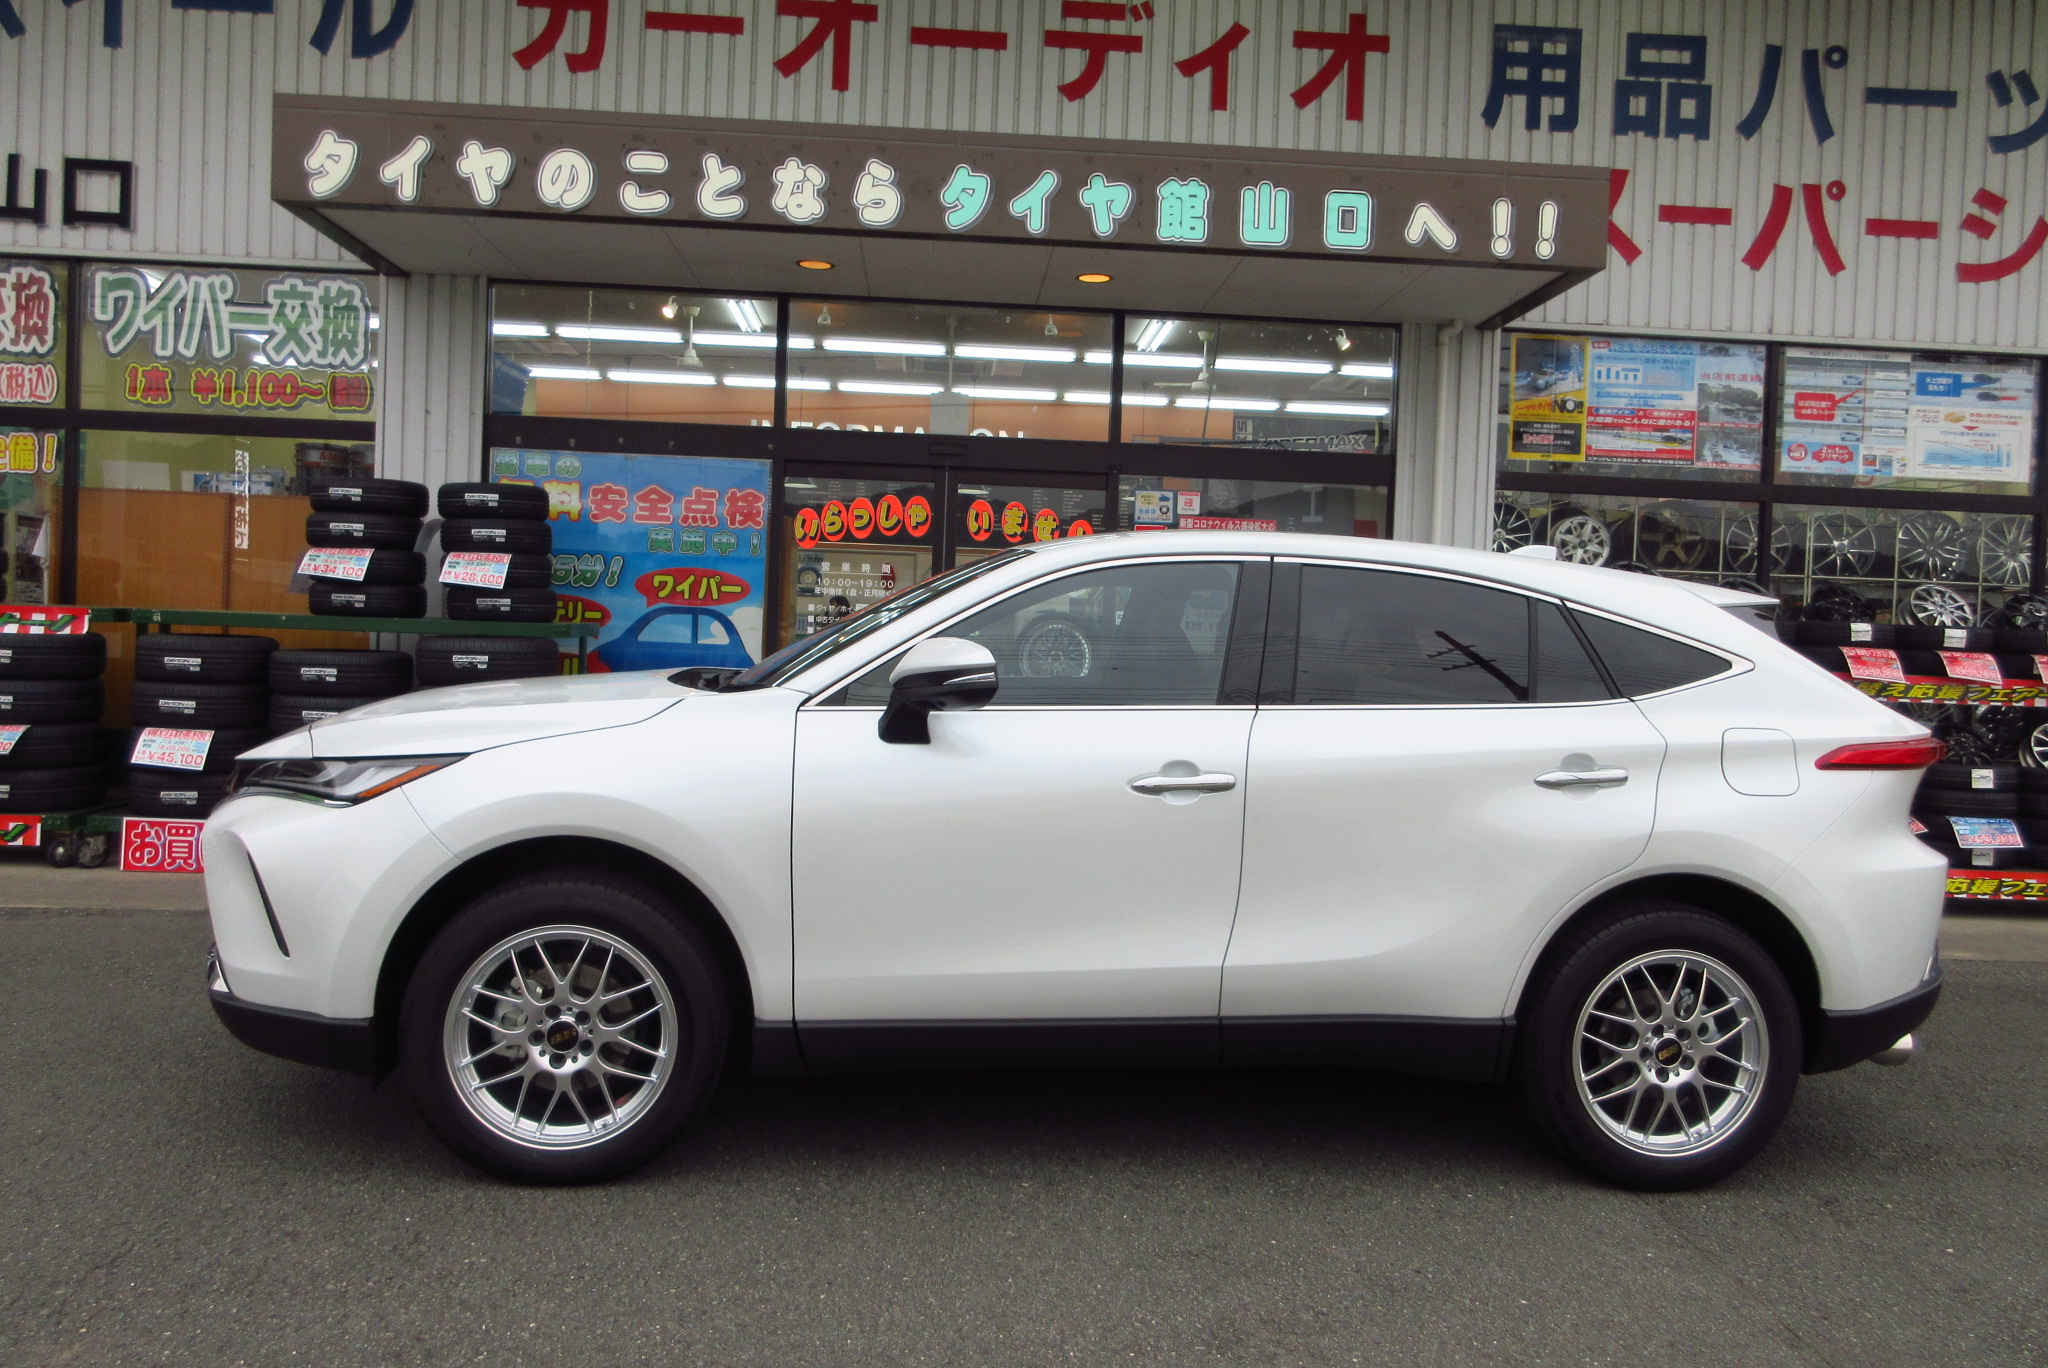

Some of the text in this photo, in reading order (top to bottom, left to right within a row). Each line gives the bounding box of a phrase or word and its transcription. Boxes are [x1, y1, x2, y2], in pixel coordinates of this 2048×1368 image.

[93, 266, 370, 371] ワイパー交換
[125, 364, 173, 404] 1本
[498, 477, 766, 530] 料安全点検
[648, 527, 761, 556] 実施中!
[821, 562, 892, 574] 営業時間
[652, 574, 742, 601] ワイパー
[129, 822, 204, 870] お買
[1658, 1044, 1679, 1060] BBS
